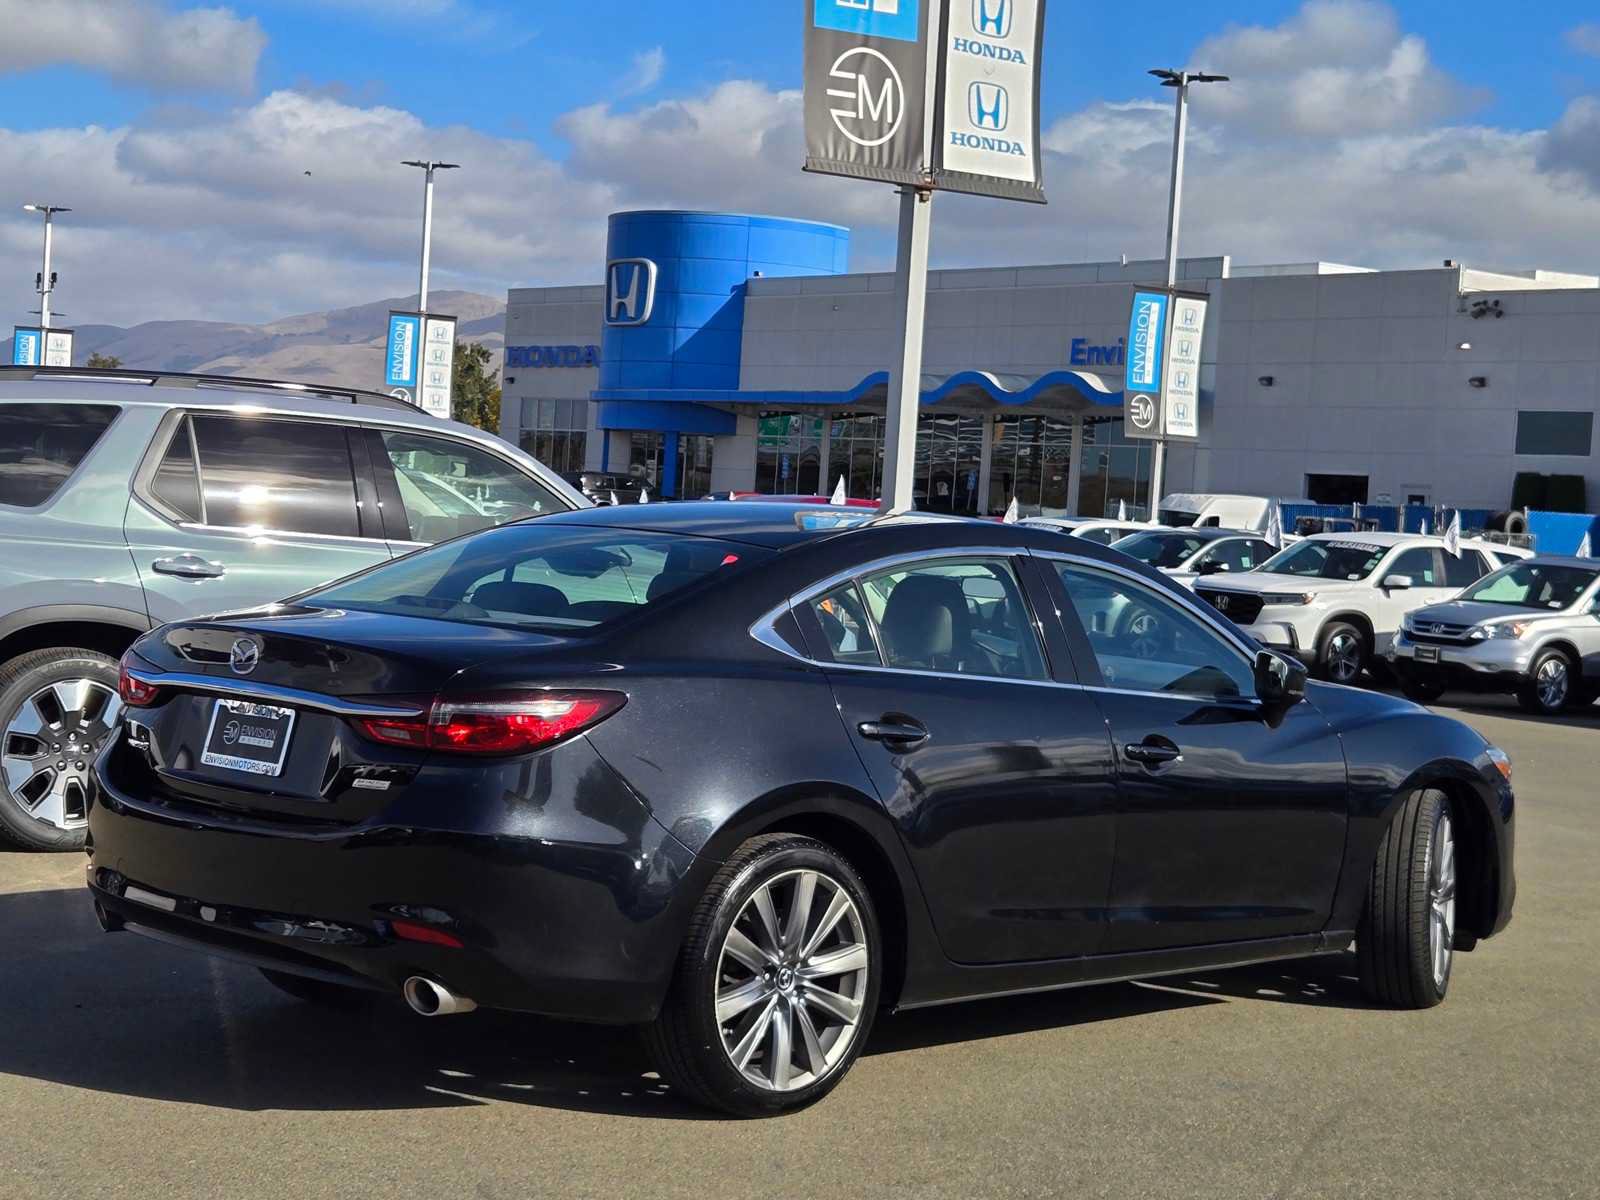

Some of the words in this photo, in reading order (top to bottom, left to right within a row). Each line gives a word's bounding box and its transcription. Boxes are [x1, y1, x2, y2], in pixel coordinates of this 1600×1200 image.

[954, 37, 1026, 65] HONDA
[950, 131, 1026, 156] HONDA
[391, 321, 407, 380] ENVISION
[1132, 300, 1153, 384] ENVISION
[240, 725, 278, 741] ENVISION
[204, 754, 278, 775] ENVISIONMOTORS.COM
